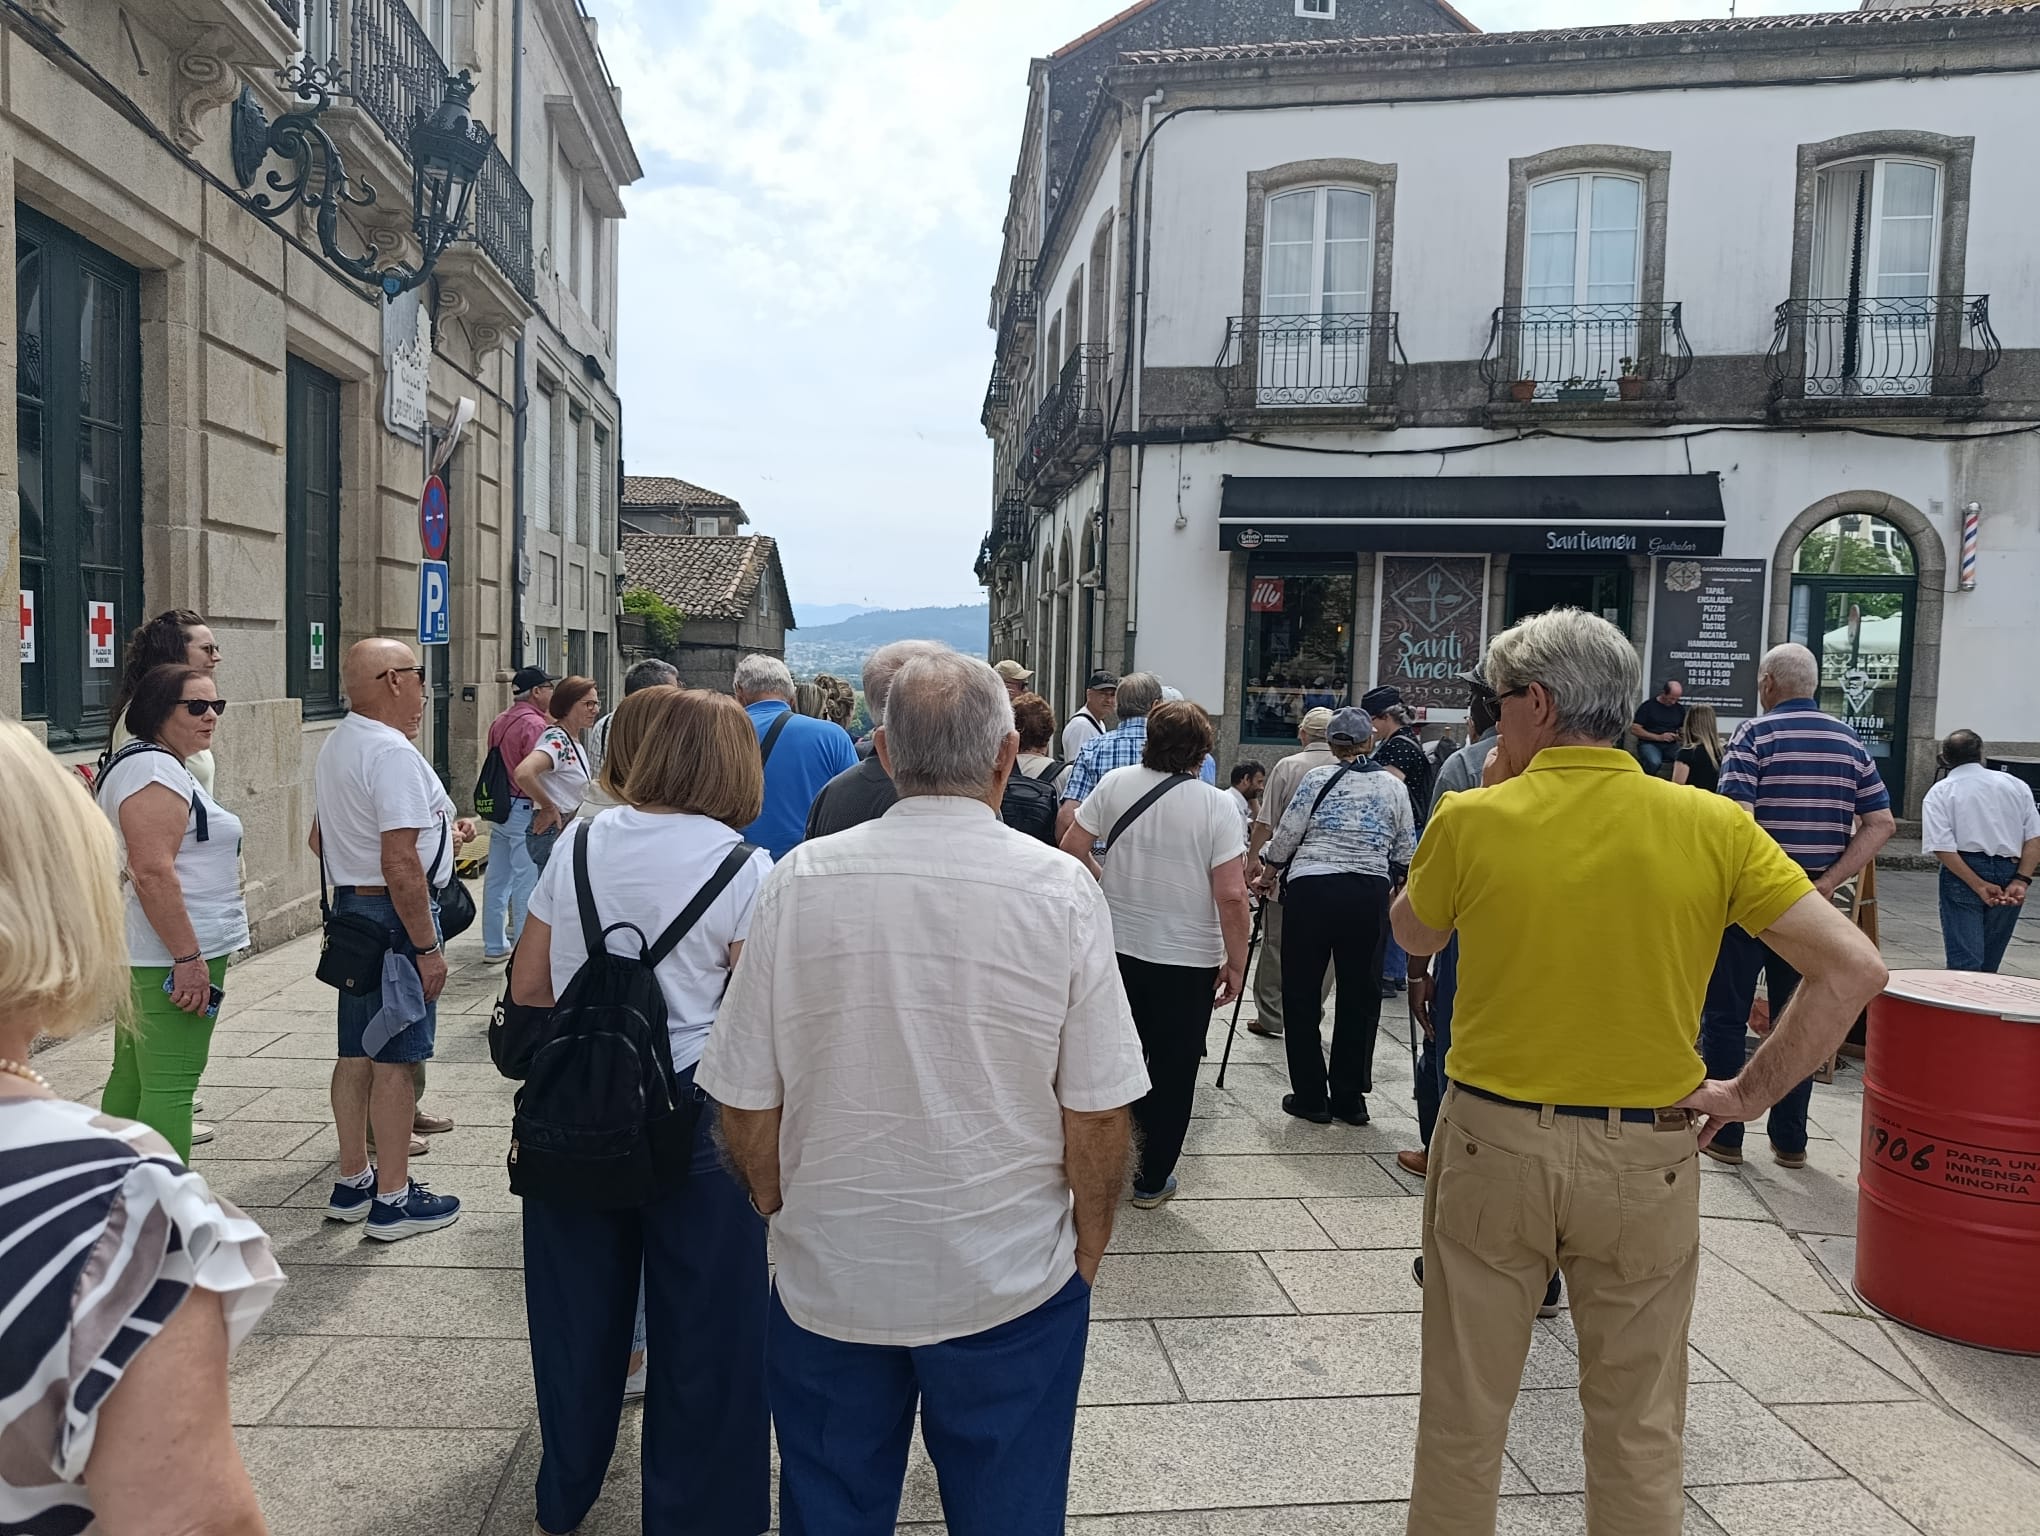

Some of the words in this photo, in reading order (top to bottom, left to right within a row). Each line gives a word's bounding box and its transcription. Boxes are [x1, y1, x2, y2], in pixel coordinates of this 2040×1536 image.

[1546, 530, 1637, 551] Santiamén
[426, 571, 443, 633] P
[1252, 583, 1280, 608] illy
[1702, 613, 1727, 621] PLATOS
[1703, 605, 1726, 613] PIZZAS
[1399, 631, 1462, 660] Santi
[1867, 1124, 1935, 1172] 1906
[1946, 1149, 2002, 1167] PARA
[1946, 1161, 2036, 1184] INMENSA
[1945, 1173, 2030, 1196] MINORÍA
